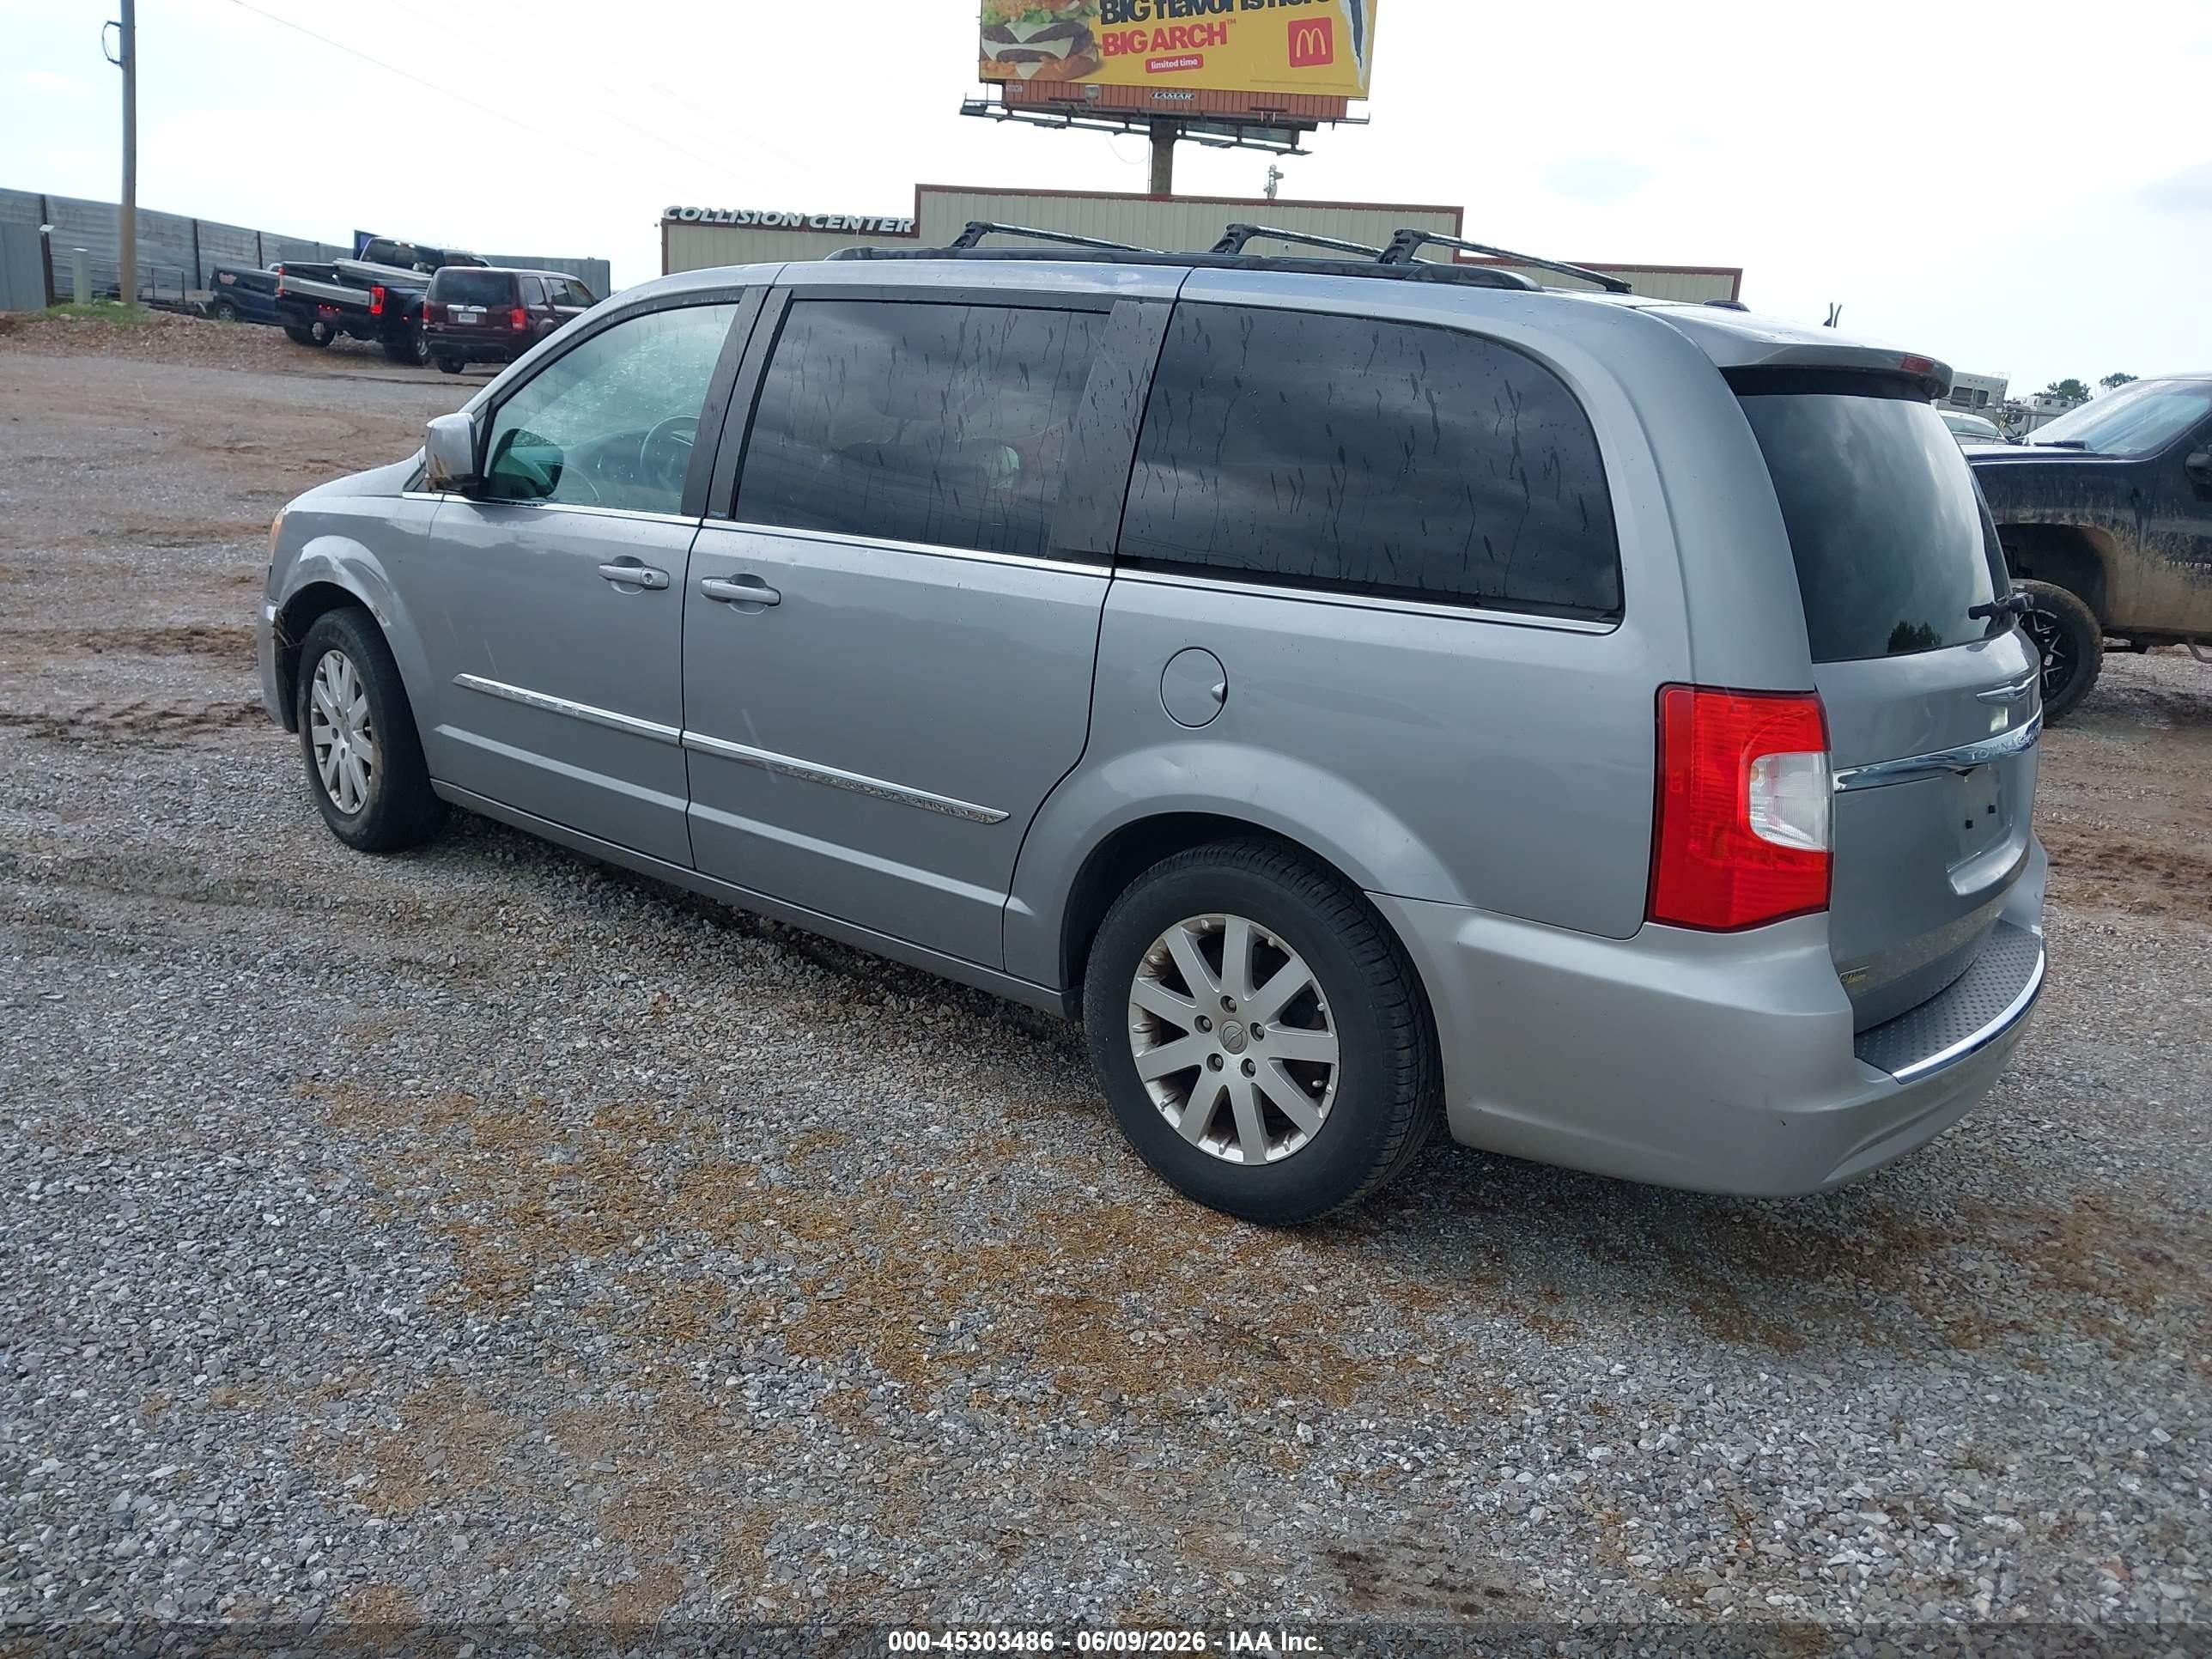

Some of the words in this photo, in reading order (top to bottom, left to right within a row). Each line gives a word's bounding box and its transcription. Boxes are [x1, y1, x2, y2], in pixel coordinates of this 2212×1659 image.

[1100, 0, 1150, 24] BIG
[1102, 30, 1147, 57] BIG
[1152, 58, 1179, 70] limited
[1180, 58, 1198, 67] time
[1154, 92, 1192, 100] LAMAR
[663, 206, 805, 228] COLLISION
[809, 214, 915, 233] CENTER
[1967, 743, 2008, 760] TOWN
